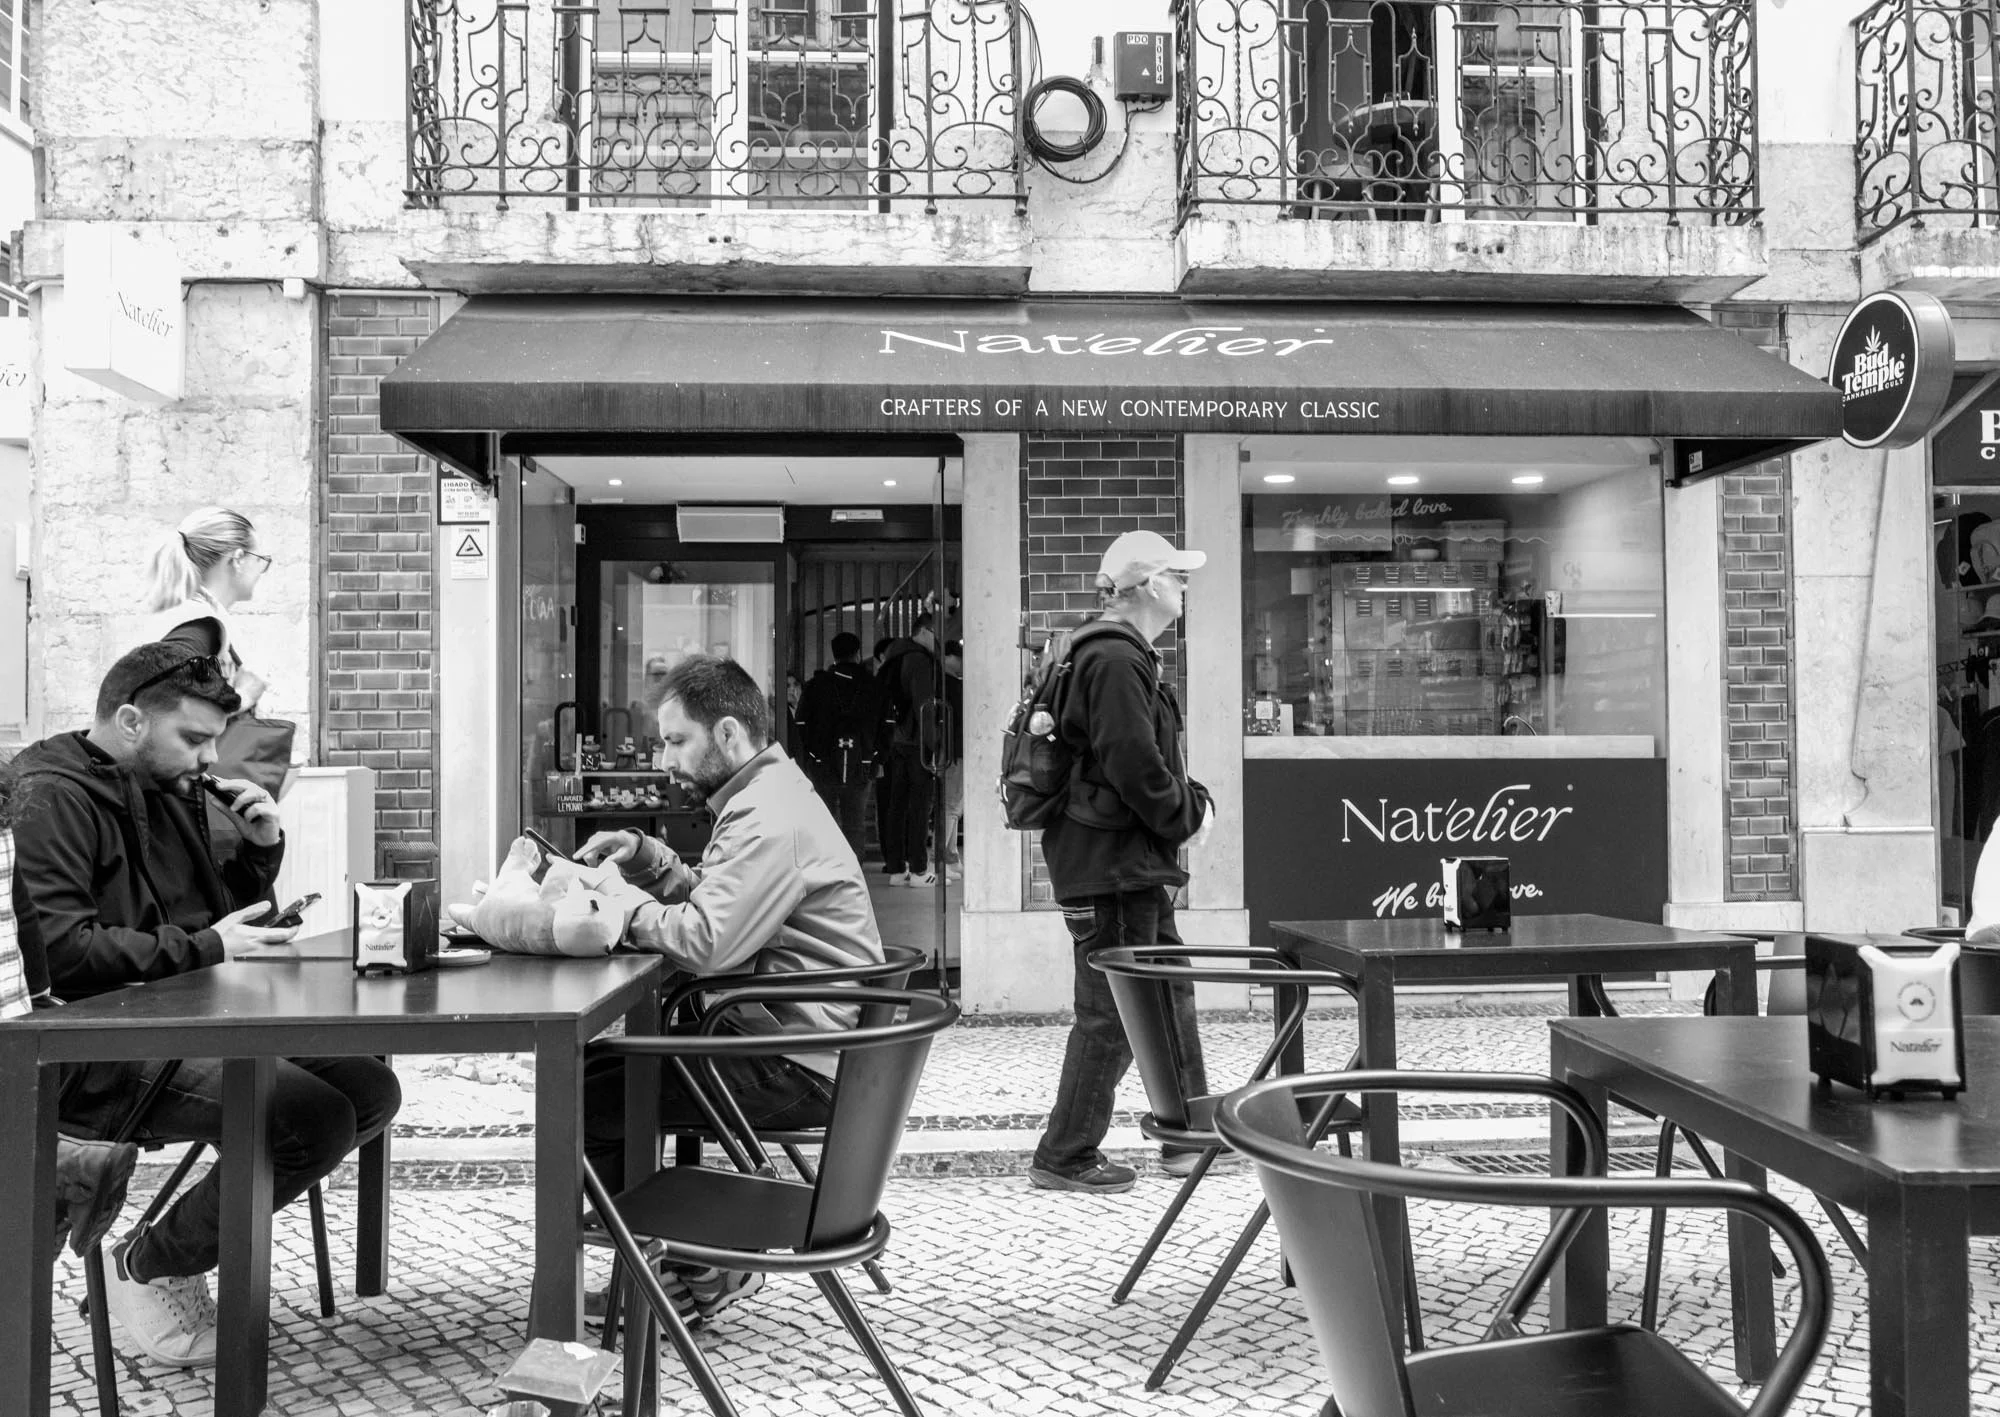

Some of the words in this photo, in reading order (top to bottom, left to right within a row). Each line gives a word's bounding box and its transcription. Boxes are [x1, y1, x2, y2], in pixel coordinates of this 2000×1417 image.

[1854, 342, 1889, 376] Bud
[1841, 356, 1905, 396] Temple
[1885, 377, 1904, 389] CULT
[880, 398, 982, 416] CRAFTERS
[995, 399, 1023, 416] OF
[1035, 399, 1049, 416] A
[1062, 399, 1108, 417] NEW
[1120, 400, 1288, 418] CONTEMPORARY
[1300, 401, 1380, 419] CLASSIC
[1355, 498, 1409, 521] baked
[1411, 497, 1452, 517] love.
[1372, 882, 1419, 918] We
